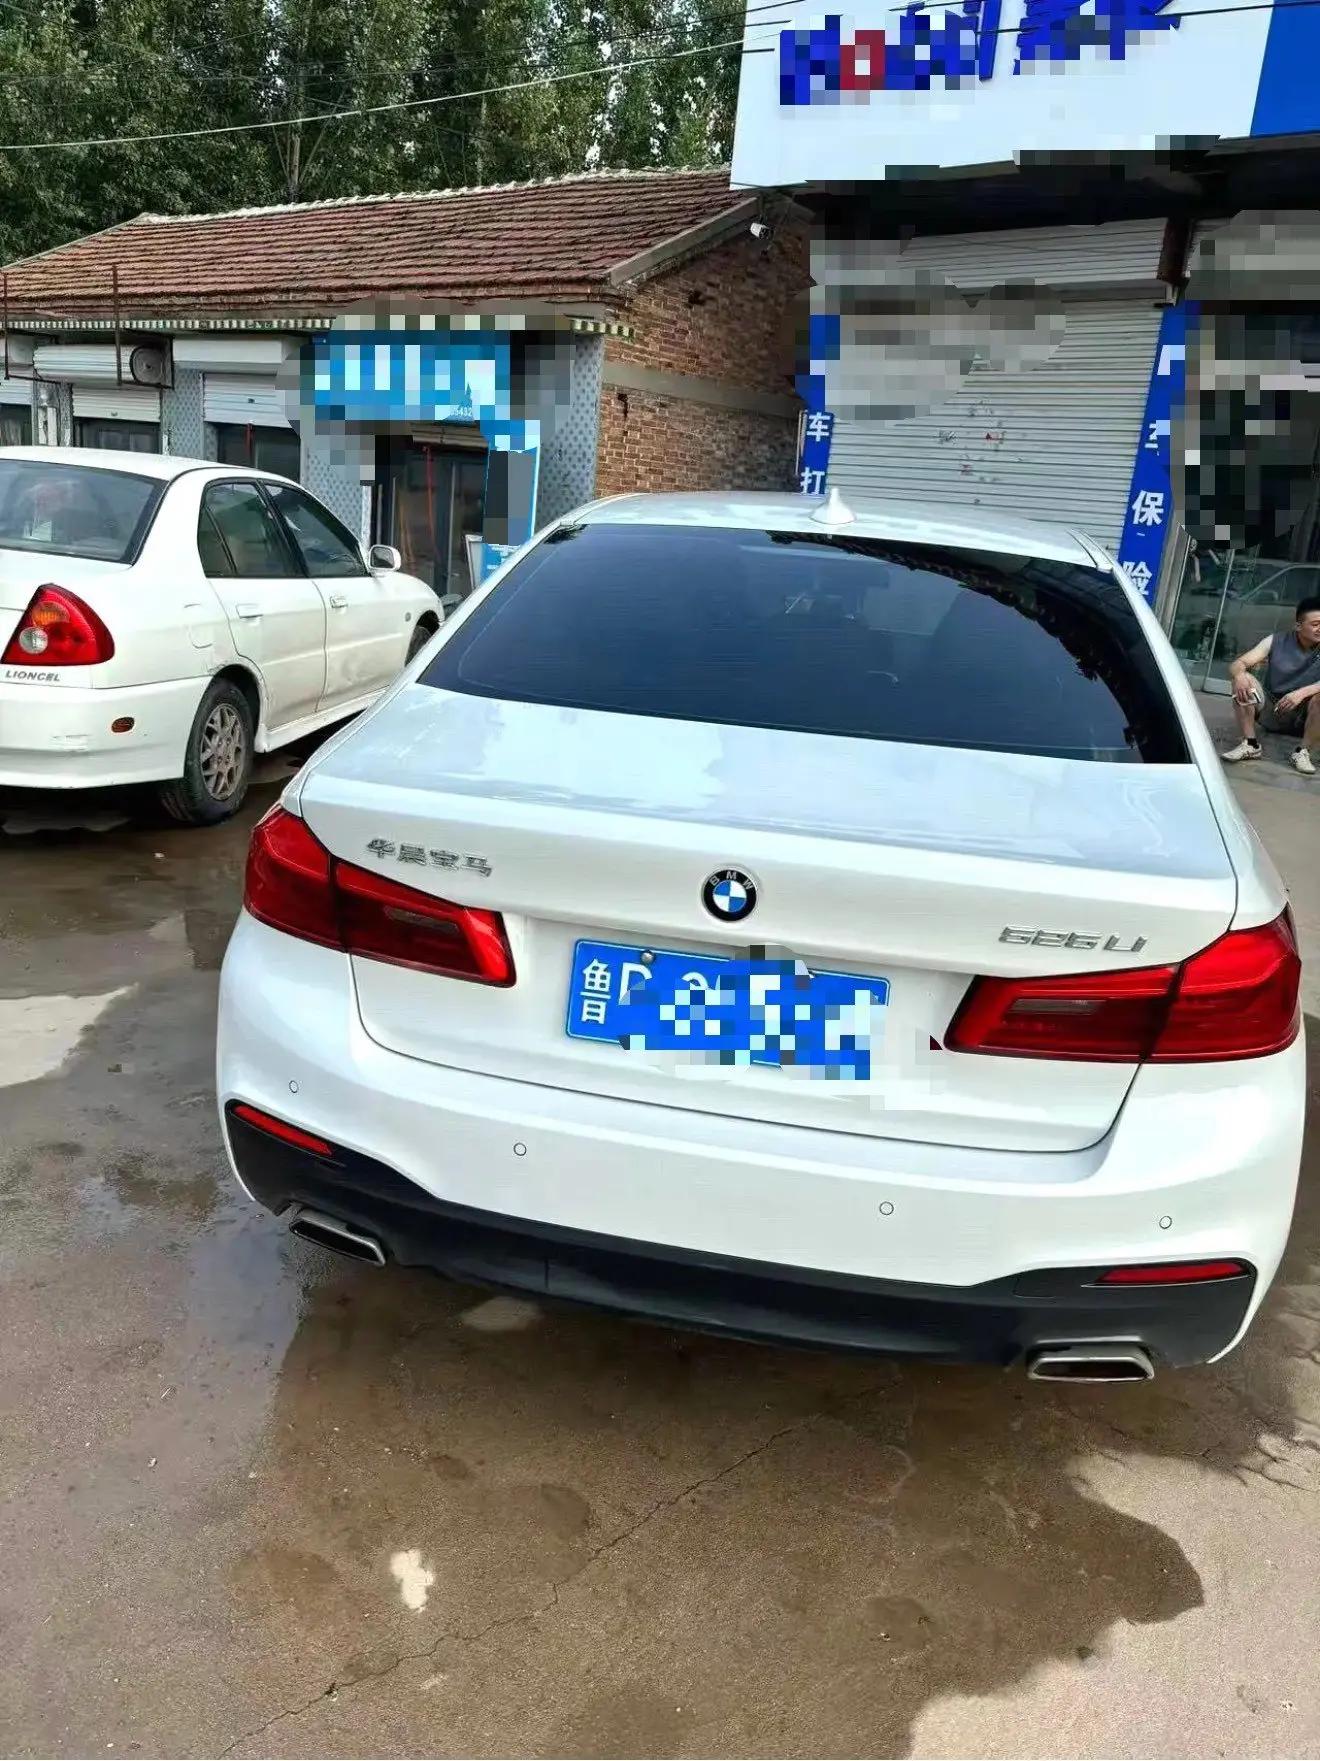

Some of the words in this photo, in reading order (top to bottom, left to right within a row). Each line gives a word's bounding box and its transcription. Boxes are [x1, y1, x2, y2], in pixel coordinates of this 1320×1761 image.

[5, 669, 60, 682] LIONCEL
[366, 837, 493, 878] 华晨宝马
[710, 870, 754, 890] BMW
